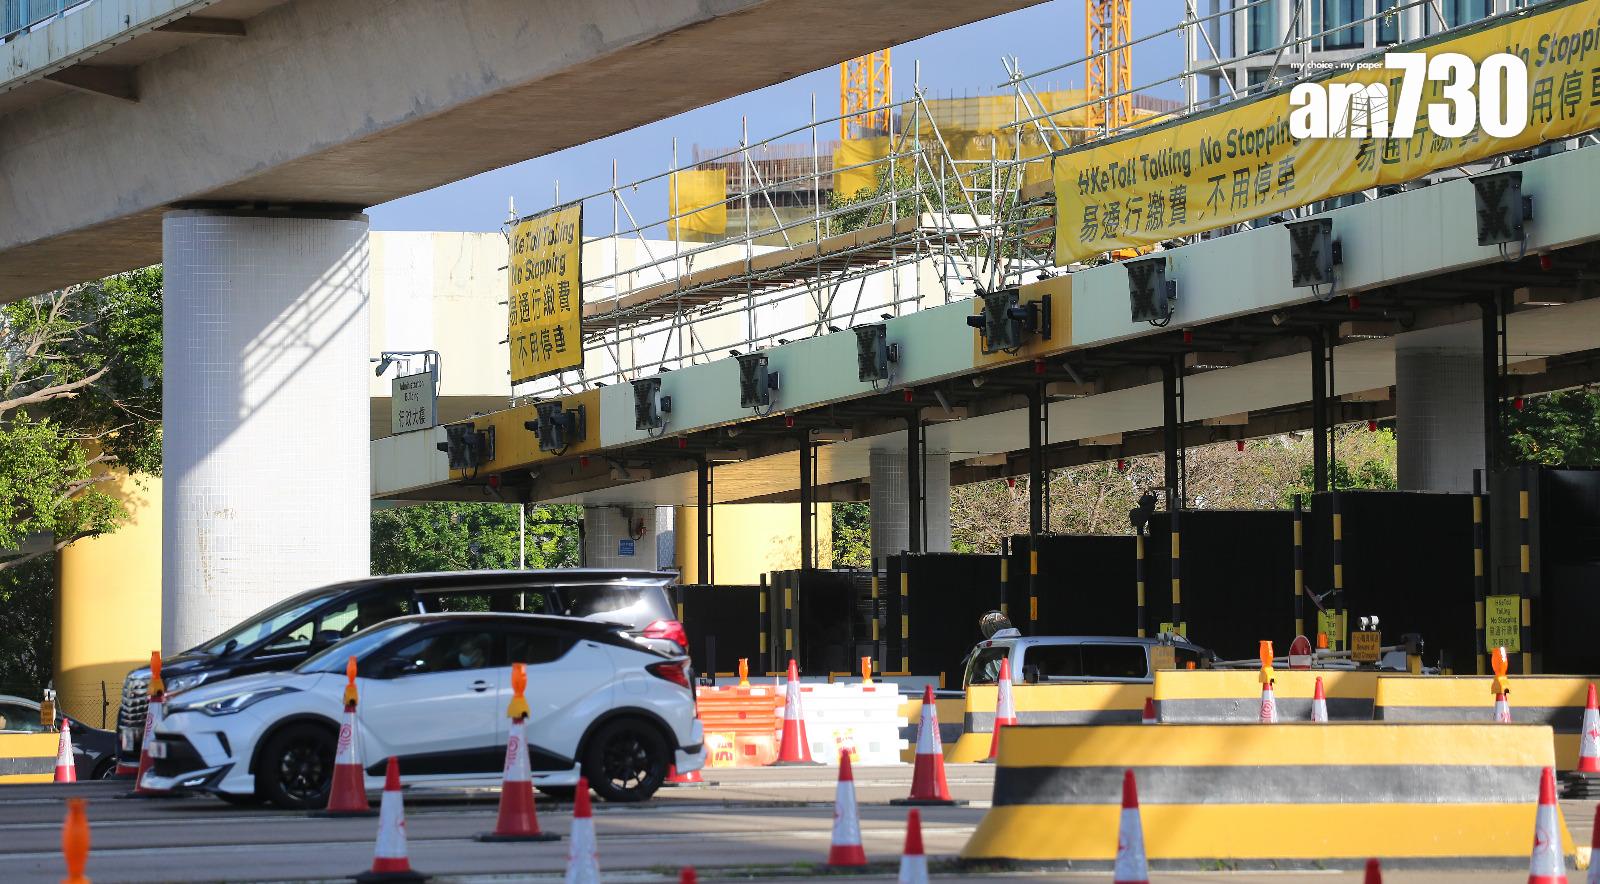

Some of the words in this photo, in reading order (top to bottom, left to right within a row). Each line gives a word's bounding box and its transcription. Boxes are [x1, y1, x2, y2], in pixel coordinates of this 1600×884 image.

[1078, 157, 1137, 196] HKeToll
[1140, 147, 1192, 182] Tolling
[1200, 138, 1222, 167] No
[1079, 183, 1187, 245] 易通行繳費
[1206, 154, 1296, 217] 不用停車
[511, 228, 541, 257] KeToll
[543, 223, 575, 247] Tolling
[511, 263, 522, 286] No
[525, 251, 566, 281] Stopping
[509, 280, 570, 326] 易通行繳費
[516, 325, 566, 366] 不用停車
